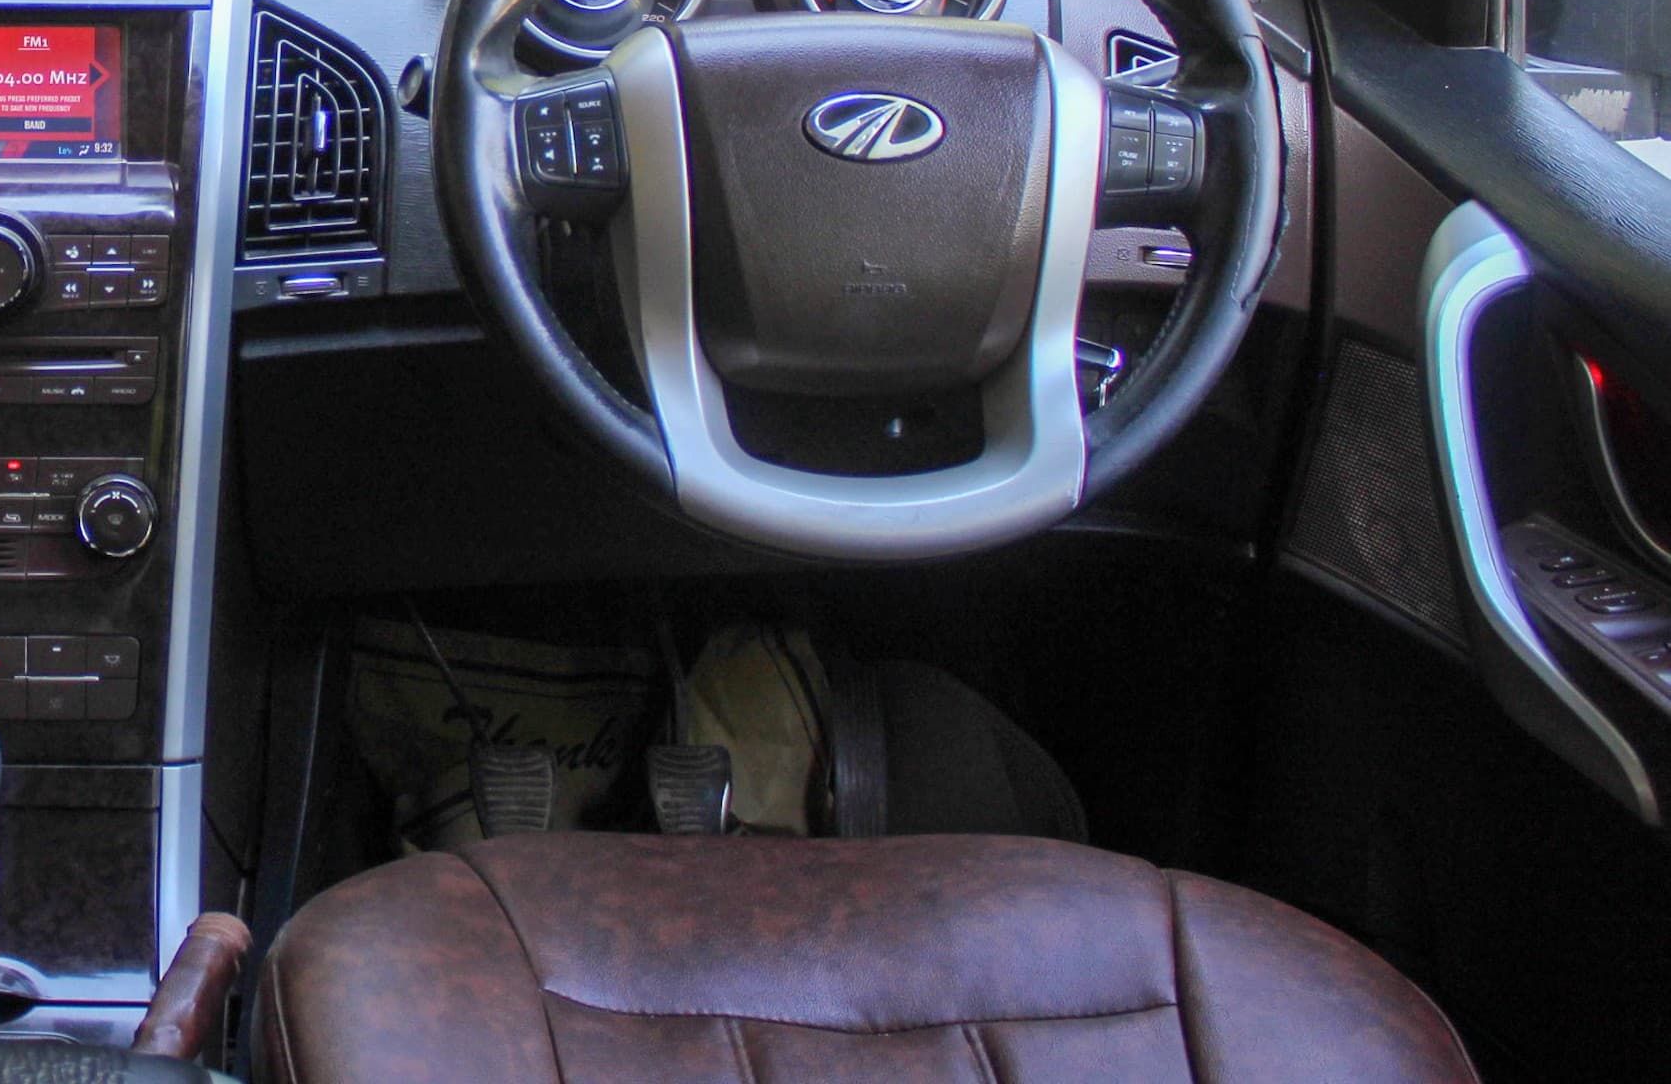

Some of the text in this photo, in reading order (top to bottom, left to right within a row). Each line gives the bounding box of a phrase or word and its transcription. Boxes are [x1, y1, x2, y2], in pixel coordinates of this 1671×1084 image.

[642, 14, 665, 23] 220
[23, 35, 48, 47] FM1
[7, 95, 26, 103] PRESS
[26, 95, 59, 103] PREFERRED
[60, 95, 81, 103] PRESET
[1, 104, 71, 112] TO SAVE NEW FREQUENCY
[578, 100, 601, 109] SOURCE
[23, 120, 46, 130] BAND
[94, 142, 113, 154] 9:32
[41, 387, 66, 395] MUSIC
[111, 387, 137, 395] RADIO
